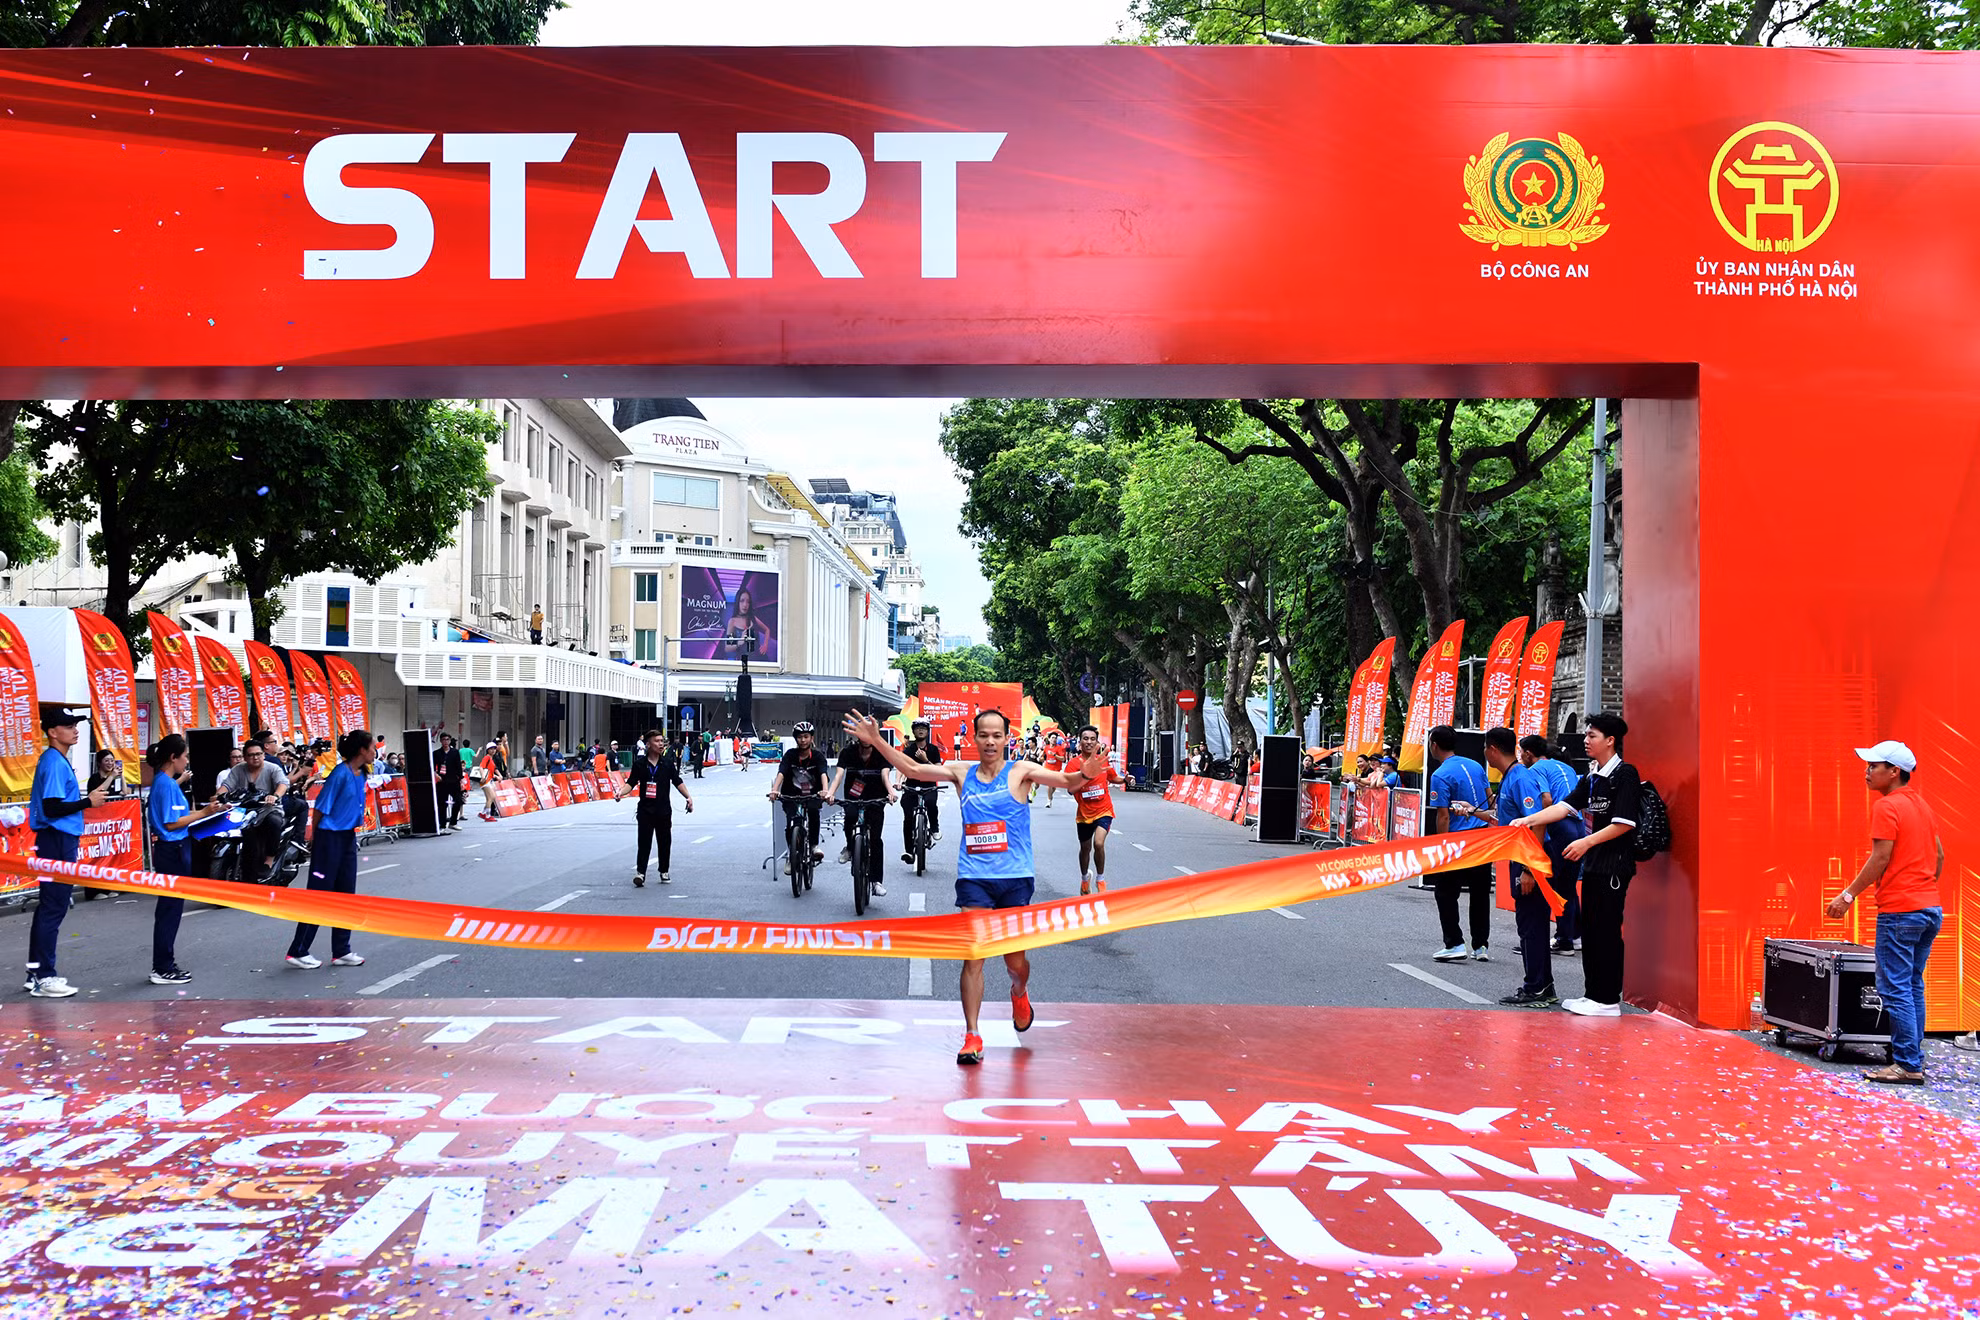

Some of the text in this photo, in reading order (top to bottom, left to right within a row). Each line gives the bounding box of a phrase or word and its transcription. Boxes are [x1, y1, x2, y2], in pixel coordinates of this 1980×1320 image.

[303, 132, 1008, 279] START
[1757, 237, 1794, 254] HÀ NỘI
[1481, 259, 1589, 281] BỘ CÔNG AN
[1696, 256, 1855, 278] ỦY BAN NHÂN DÂN
[1693, 278, 1857, 300] THÀNH PHỐ HÀ NỘI
[653, 432, 720, 450] TRANG TIEN
[675, 447, 698, 456] PLAZA
[687, 598, 727, 610] MAGNUM
[15, 694, 30, 716] MA
[117, 694, 131, 713] MA
[179, 692, 192, 711] MA
[1374, 701, 1382, 717] MA
[1444, 695, 1453, 712] MA
[1497, 698, 1508, 715] MA
[1531, 708, 1544, 727] MA
[99, 835, 115, 858] MA
[974, 835, 998, 843] 10089
[1316, 853, 1382, 873] VÌ CỘNG ĐỒNG
[1383, 849, 1423, 882] MA
[646, 924, 738, 949] ĐÍCH
[763, 927, 892, 950] FINISH
[186, 1016, 1072, 1048] START
[942, 1098, 1518, 1136] CHẠY
[210, 1126, 1024, 1170] QUYẾT
[1068, 1135, 1650, 1184] TÂM
[302, 1174, 938, 1268] MA
[998, 1177, 1720, 1278] TÚY
